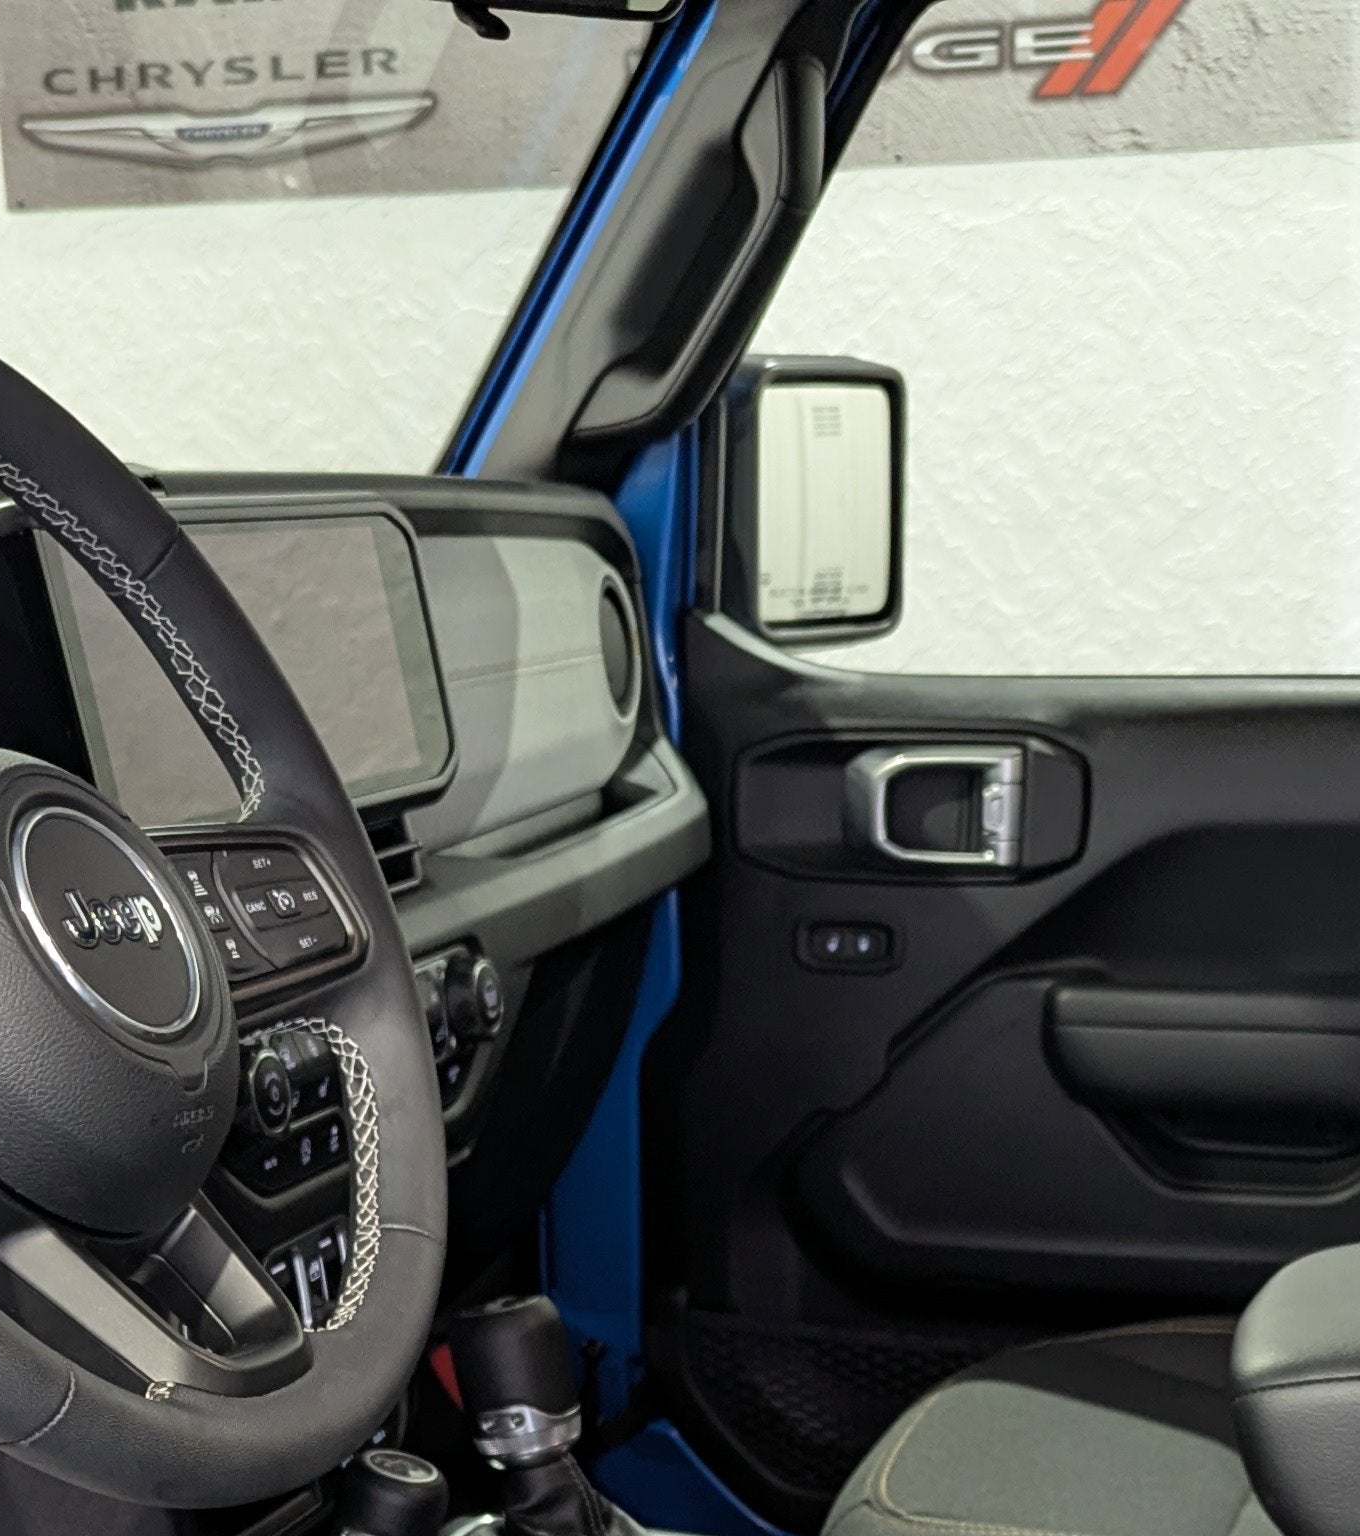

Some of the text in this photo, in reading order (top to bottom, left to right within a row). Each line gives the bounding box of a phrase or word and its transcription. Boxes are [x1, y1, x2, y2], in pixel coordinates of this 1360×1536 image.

[42, 48, 399, 96] CHRYSLER
[61, 888, 163, 951] Jeep
[302, 890, 319, 902] RES
